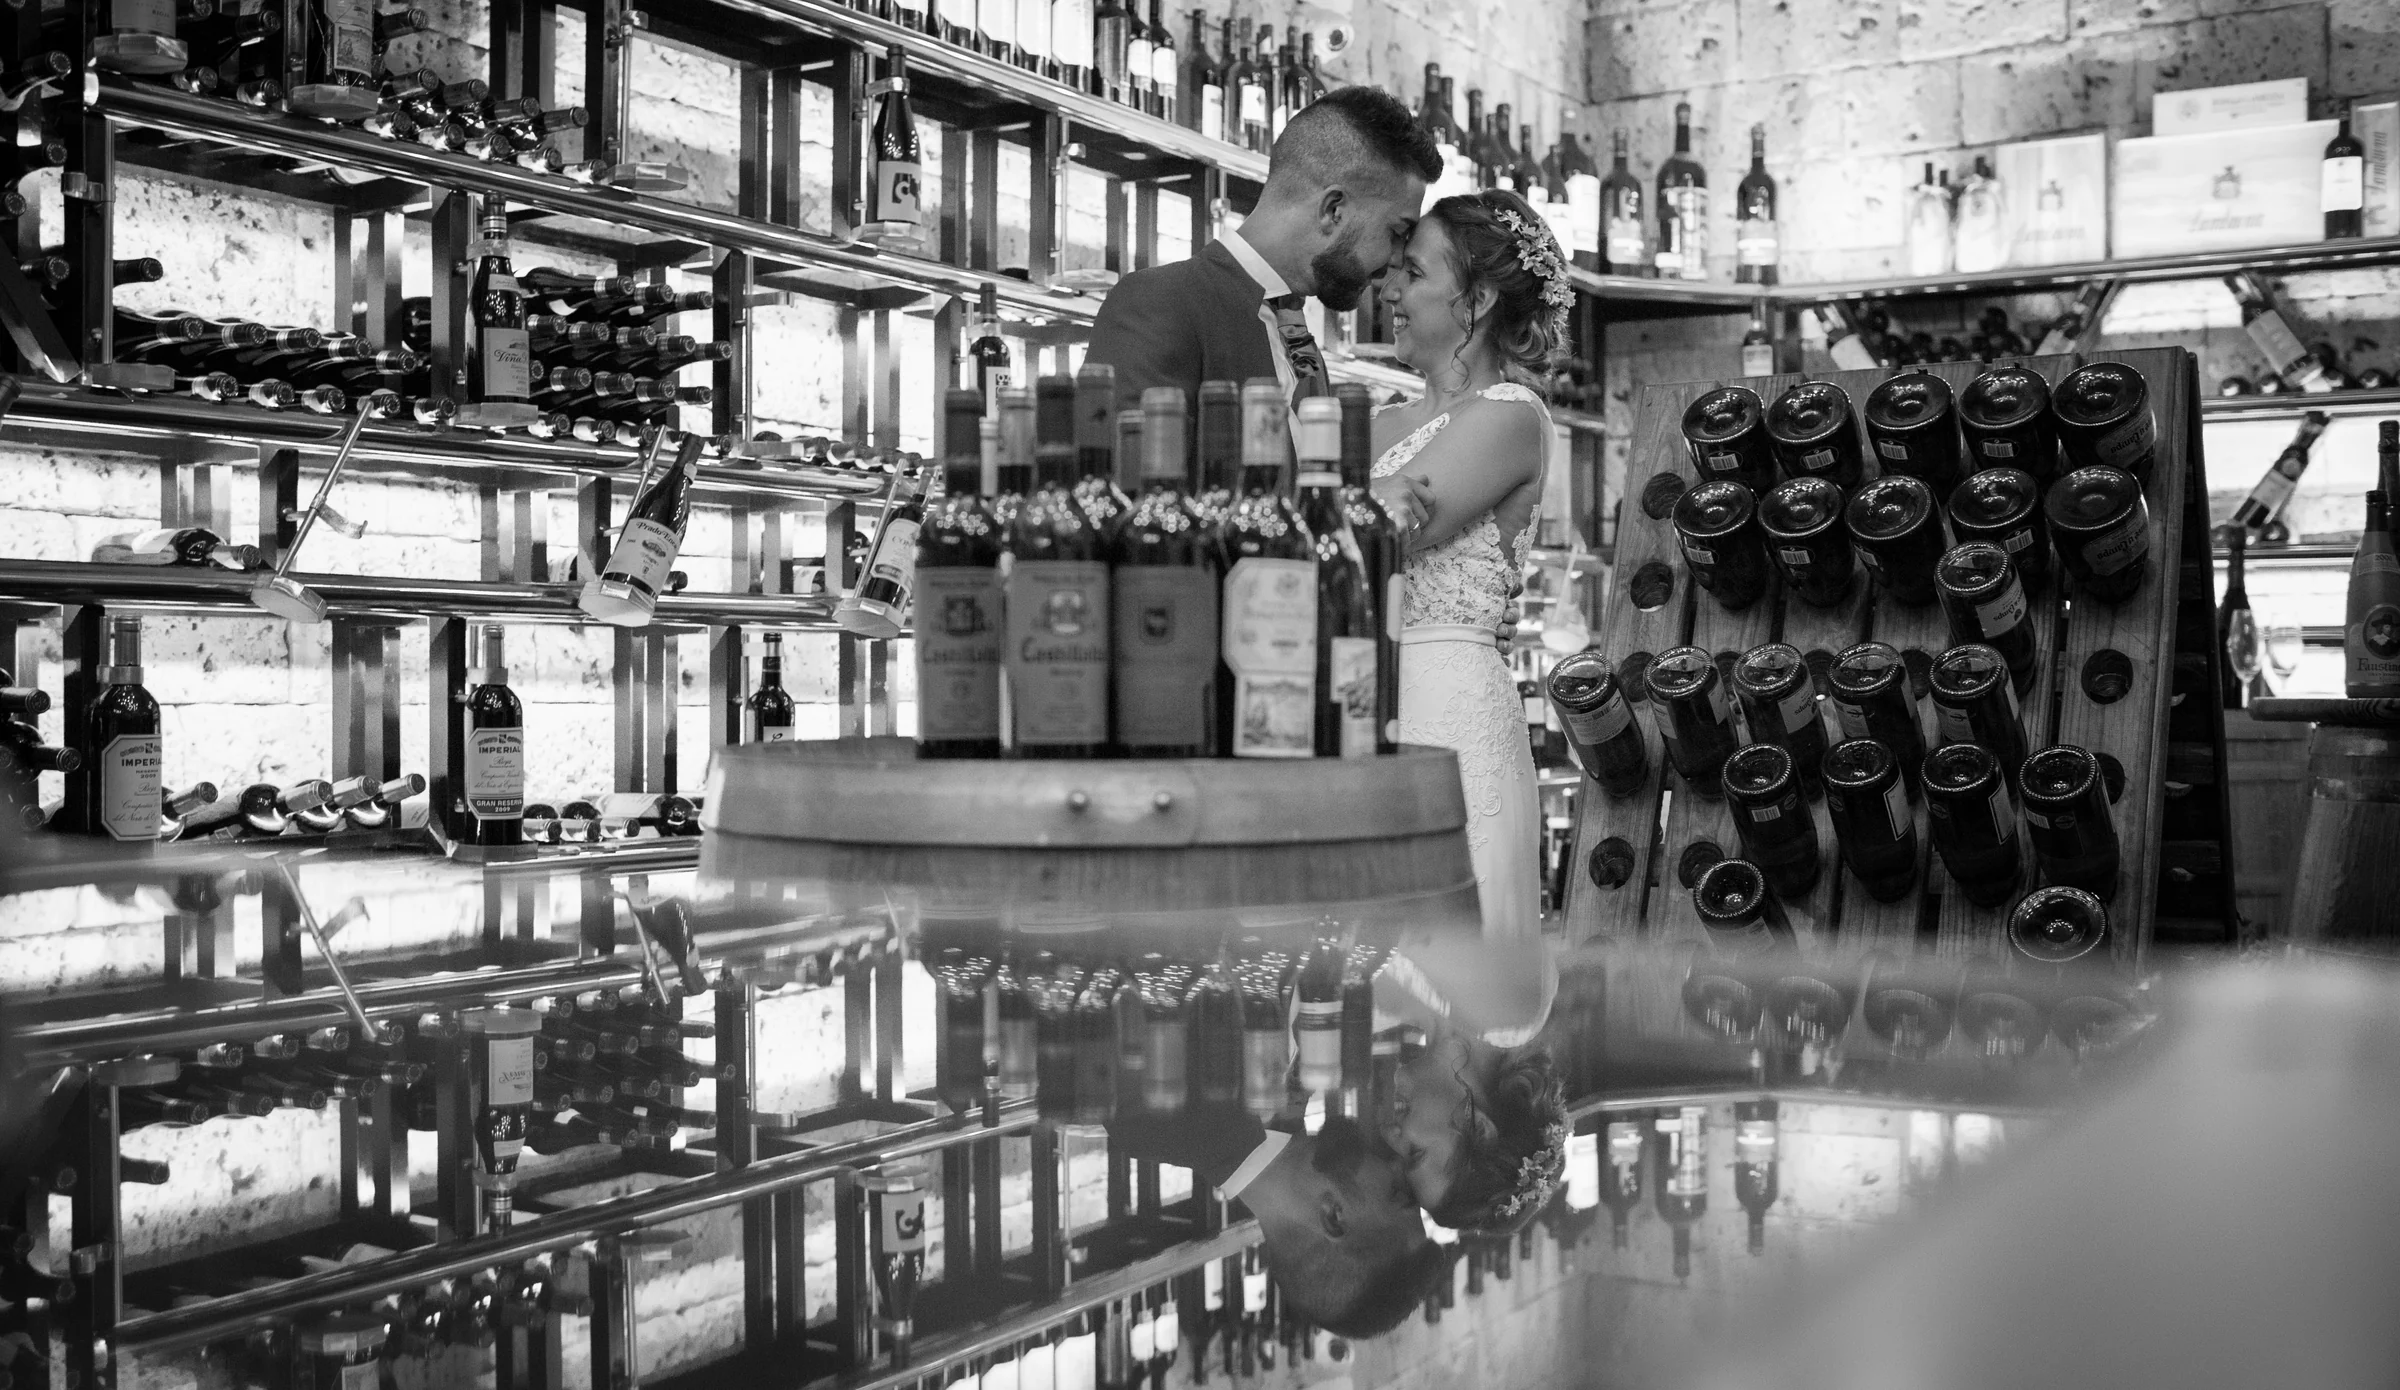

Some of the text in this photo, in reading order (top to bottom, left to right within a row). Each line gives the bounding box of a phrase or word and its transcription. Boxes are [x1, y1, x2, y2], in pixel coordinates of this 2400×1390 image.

[494, 349, 522, 363] Viña
[636, 522, 663, 536] Prado
[478, 746, 521, 754] IMPERIAL
[121, 758, 161, 767] IMPERIA
